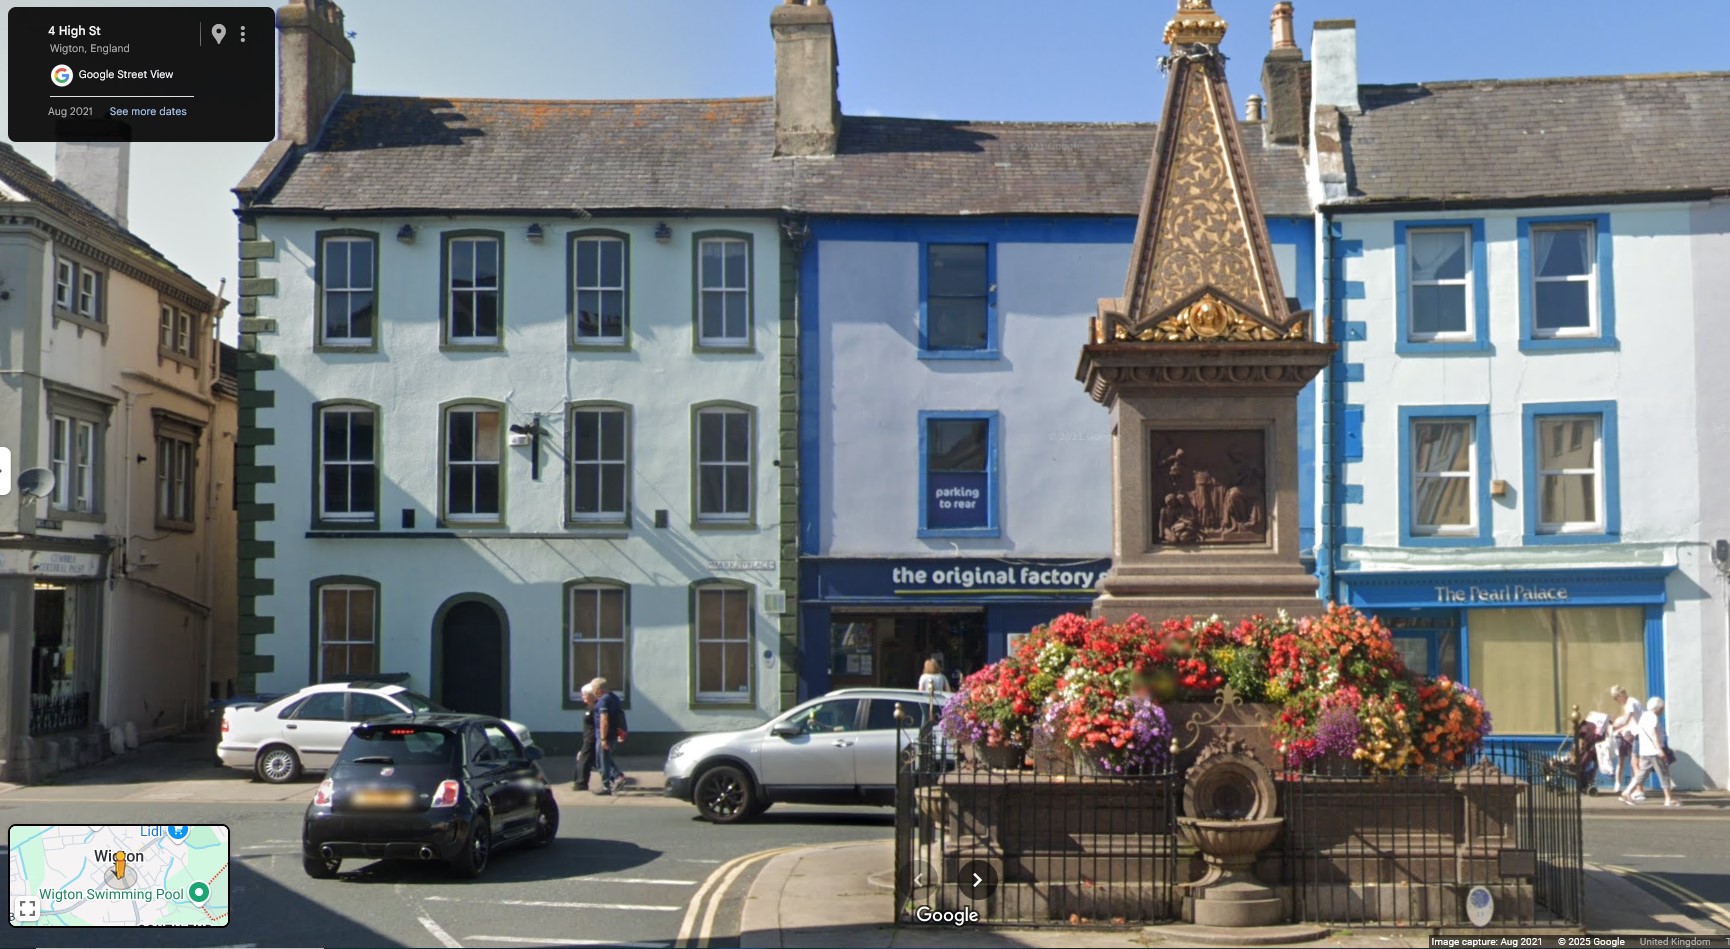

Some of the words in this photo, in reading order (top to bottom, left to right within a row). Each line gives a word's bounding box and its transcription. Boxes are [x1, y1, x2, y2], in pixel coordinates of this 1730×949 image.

[936, 487, 980, 499] parking
[939, 499, 952, 509] to
[953, 500, 976, 509] rear
[892, 566, 927, 584] the
[932, 567, 1016, 588] original
[1020, 567, 1094, 588] factory
[1435, 586, 1466, 602] The
[1470, 585, 1511, 602] Pearl
[1514, 585, 1568, 601] Palace
